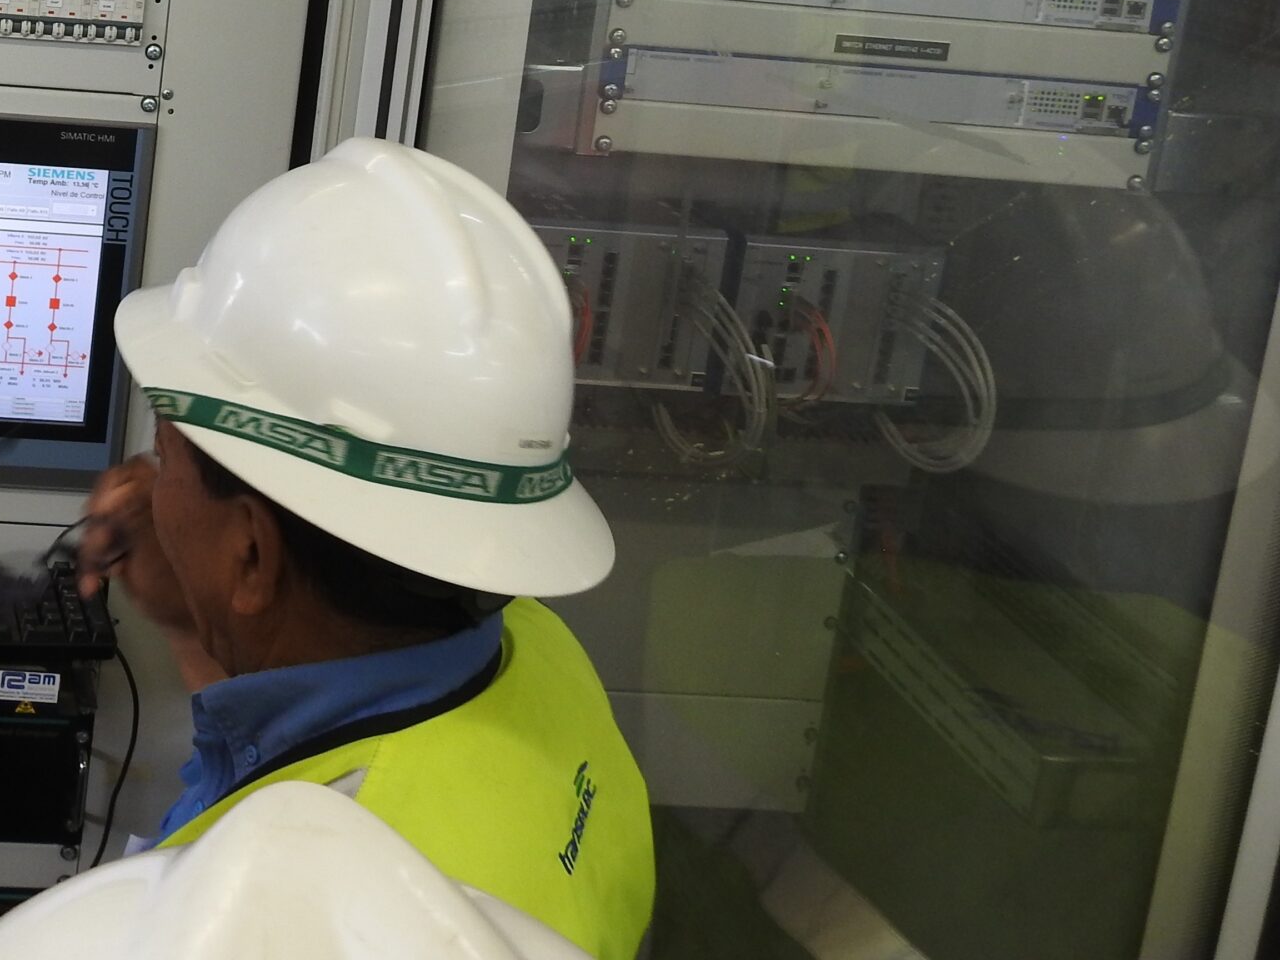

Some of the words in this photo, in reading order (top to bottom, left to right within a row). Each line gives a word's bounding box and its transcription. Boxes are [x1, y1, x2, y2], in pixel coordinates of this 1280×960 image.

[60, 131, 96, 142] SIMATIC
[98, 134, 116, 144] HMI
[28, 168, 96, 181] SIEMENS
[28, 178, 48, 186] Temp
[51, 190, 68, 198] Nivel
[80, 192, 104, 200] Control
[106, 174, 134, 244] TOUCH
[221, 409, 336, 460] MSA
[377, 458, 492, 495] MSA
